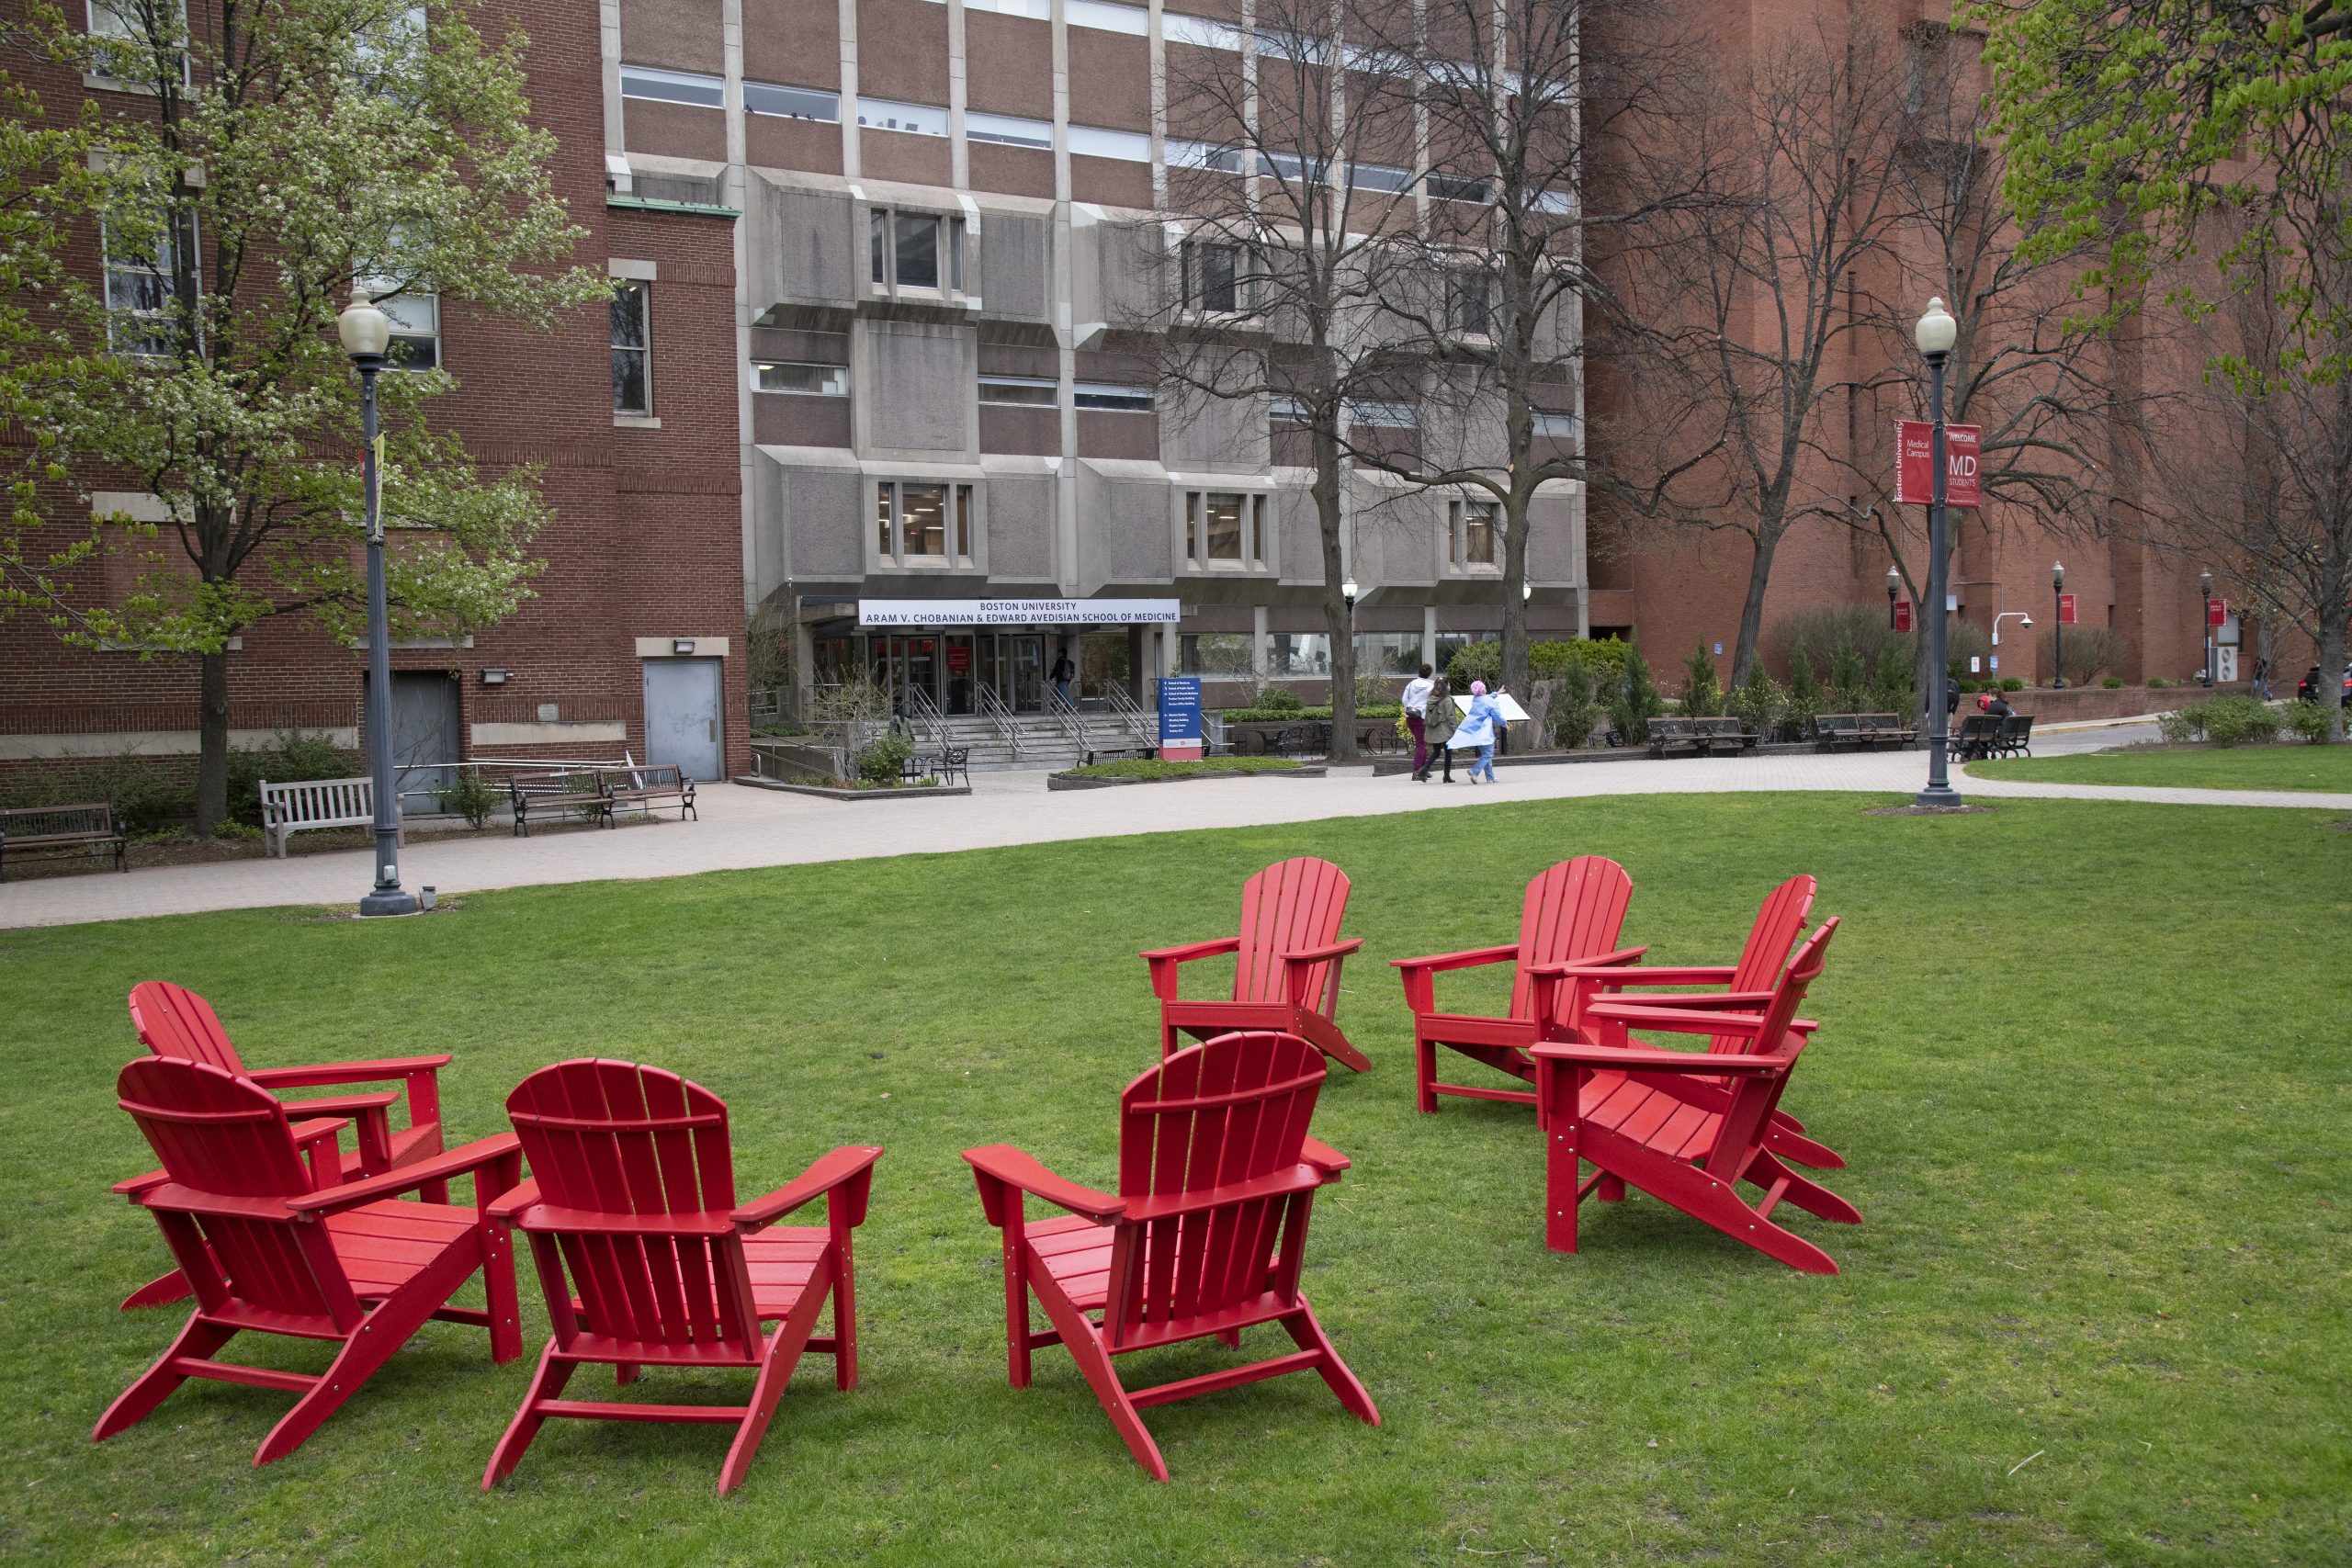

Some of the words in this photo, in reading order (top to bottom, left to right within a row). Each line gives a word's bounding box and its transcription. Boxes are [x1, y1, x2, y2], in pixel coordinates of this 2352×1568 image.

[1949, 434, 1976, 443] WELCOME
[1906, 439, 1929, 449] Medical
[1906, 448, 1930, 458] Campus
[1949, 455, 1977, 477] MD
[1949, 478, 1976, 487] STUDENTS
[979, 603, 1019, 611] BOSTON
[1022, 602, 1077, 611] UNIVERSITY
[865, 614, 898, 623] ARAM
[900, 614, 910, 623] V.
[913, 614, 974, 623] CHOBANIAN
[977, 614, 984, 622] &
[986, 614, 1027, 623] EDWARD
[1030, 614, 1080, 622] AVEDISIAN
[1082, 613, 1118, 622] SCHOOL
[1120, 613, 1132, 621] OF
[1134, 613, 1176, 621] MEDICINE
